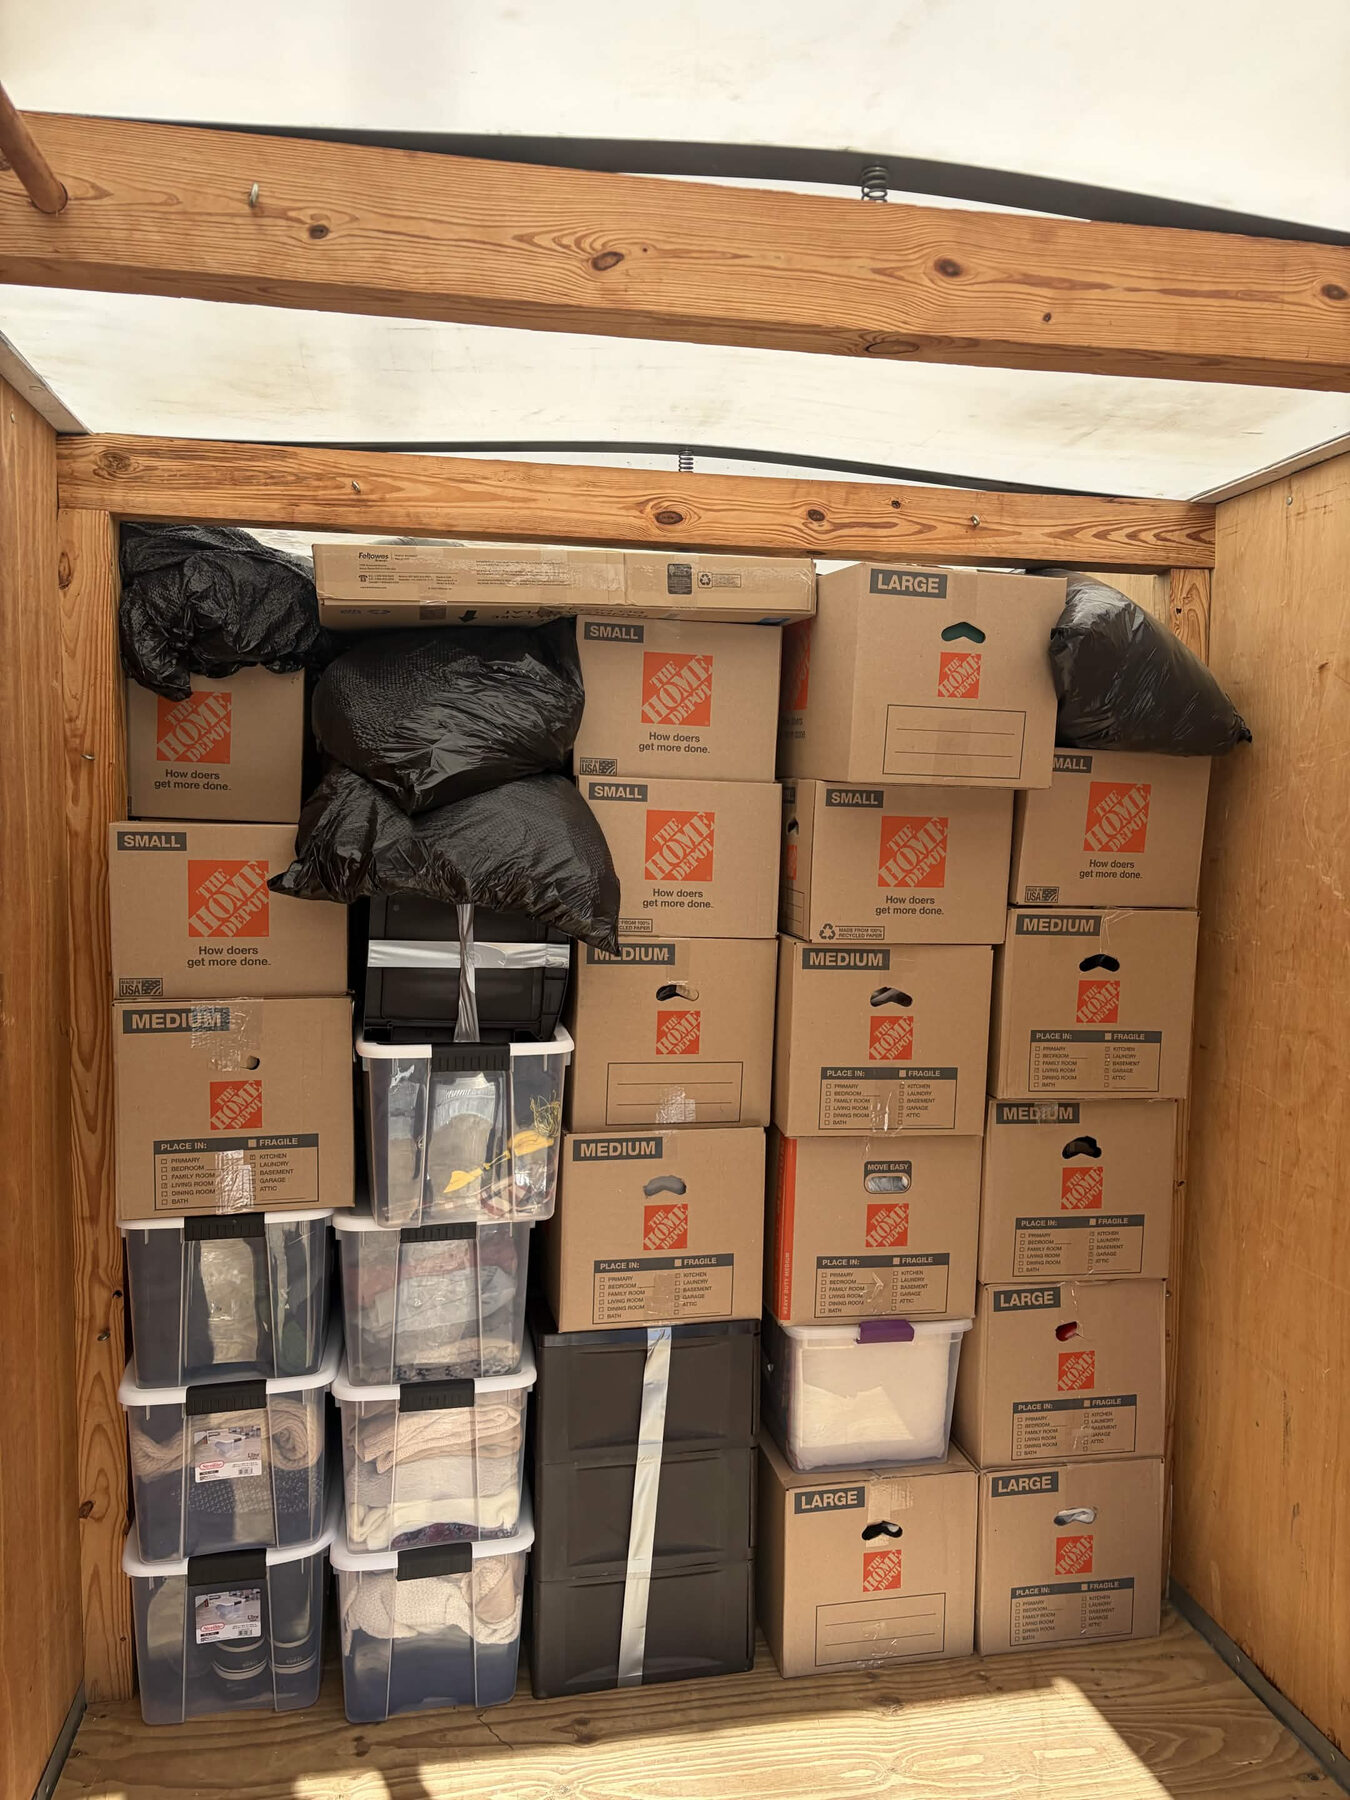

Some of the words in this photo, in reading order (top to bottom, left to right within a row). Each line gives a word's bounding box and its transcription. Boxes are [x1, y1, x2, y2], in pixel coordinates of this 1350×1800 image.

[358, 552, 389, 560] Fellowes
[877, 574, 939, 593] LARGE
[589, 625, 639, 640] SMALL
[649, 661, 679, 689] THE
[943, 657, 962, 675] THE
[938, 653, 982, 698] HOME
[641, 654, 713, 724] HOME
[955, 672, 980, 698] DEPOT
[668, 682, 712, 726] DEPOT
[165, 701, 197, 726] THE
[157, 692, 233, 761] HOME
[186, 719, 232, 762] DEPOT
[649, 732, 671, 741] How
[673, 733, 700, 743] doers
[639, 743, 655, 752] get
[684, 744, 711, 754] done.
[581, 764, 598, 774] USA
[1053, 758, 1087, 770] MALL
[165, 769, 189, 779] How
[191, 770, 220, 780] doers
[154, 780, 171, 790] get
[174, 782, 200, 790] more
[203, 781, 232, 791] done.
[594, 786, 643, 799] SMALL
[831, 792, 879, 805] SMALL
[1093, 789, 1122, 818] THE
[1084, 784, 1151, 851] HOME
[652, 818, 682, 847] THE
[886, 824, 915, 853] THE
[1108, 810, 1149, 852] DEPOT
[123, 835, 181, 848] SMALL
[645, 812, 715, 880] HOME
[671, 837, 714, 881] DEPOT
[878, 817, 949, 887] HOME
[904, 843, 947, 887] DEPOT
[1089, 859, 1108, 868] How
[1110, 860, 1134, 869] doers
[196, 868, 230, 899] THE
[1079, 870, 1094, 879] get
[1119, 870, 1143, 879] done.
[188, 861, 269, 937] HOME
[652, 888, 675, 897] How
[676, 889, 703, 898] doers
[886, 896, 906, 904] How
[908, 896, 935, 905] doers
[1026, 892, 1041, 901] USA
[220, 889, 269, 937] DEPOT
[642, 899, 658, 909] get
[687, 900, 714, 909] done.
[875, 906, 895, 916] get
[919, 907, 944, 916] done.
[1023, 918, 1094, 932] MEDIUM
[198, 945, 224, 955] How
[226, 945, 259, 955] doers
[187, 957, 205, 969] get
[208, 958, 237, 967] more
[240, 956, 271, 967] done.
[809, 952, 883, 967] MEDIUM
[121, 984, 140, 995] USA
[1083, 985, 1100, 1002] THE
[1076, 980, 1120, 1023] HOME
[1093, 997, 1119, 1023] DEPOT
[131, 1013, 222, 1029] MEDIUM
[661, 1016, 680, 1032] THE
[874, 1021, 892, 1039] THE
[656, 1011, 701, 1054] HOME
[673, 1028, 700, 1054] DEPOT
[869, 1016, 914, 1060] HOME
[886, 1034, 913, 1060] DEPOT
[210, 1080, 263, 1130] HOME
[215, 1086, 236, 1106] THE
[231, 1099, 263, 1130] DEPOT
[160, 1143, 192, 1151] PLACE
[195, 1142, 207, 1150] IN:
[259, 1138, 299, 1147] FRAGILE
[580, 1141, 656, 1157] MEDIUM
[171, 1181, 192, 1189] LIVING
[1061, 1167, 1103, 1209] HOME
[1066, 1172, 1084, 1189] THE
[1077, 1183, 1103, 1209] DEPOT
[648, 1210, 668, 1228] THE
[865, 1203, 909, 1247] HOME
[871, 1208, 889, 1226] THE
[643, 1204, 688, 1250] HOME
[660, 1220, 688, 1250] DEPOT
[882, 1221, 908, 1247] DEPOT
[683, 1257, 717, 1266] FRAGILE
[902, 1256, 934, 1264] FRAGILE
[1000, 1291, 1054, 1307] LARGE
[1057, 1351, 1095, 1391] HOME
[1062, 1356, 1079, 1372] THE
[1073, 1366, 1095, 1391] DEPOT
[998, 1476, 1052, 1493] LARGE
[801, 1491, 858, 1509] LARGE
[1055, 1535, 1093, 1575] HOME
[1060, 1541, 1075, 1557] THE
[863, 1550, 902, 1591] HOME
[867, 1556, 884, 1572] THE
[1070, 1550, 1093, 1574] DEPOT
[878, 1564, 902, 1591] DEPOT
[1089, 1581, 1120, 1589] FRAGILE
[1016, 1588, 1039, 1596] PLACE
